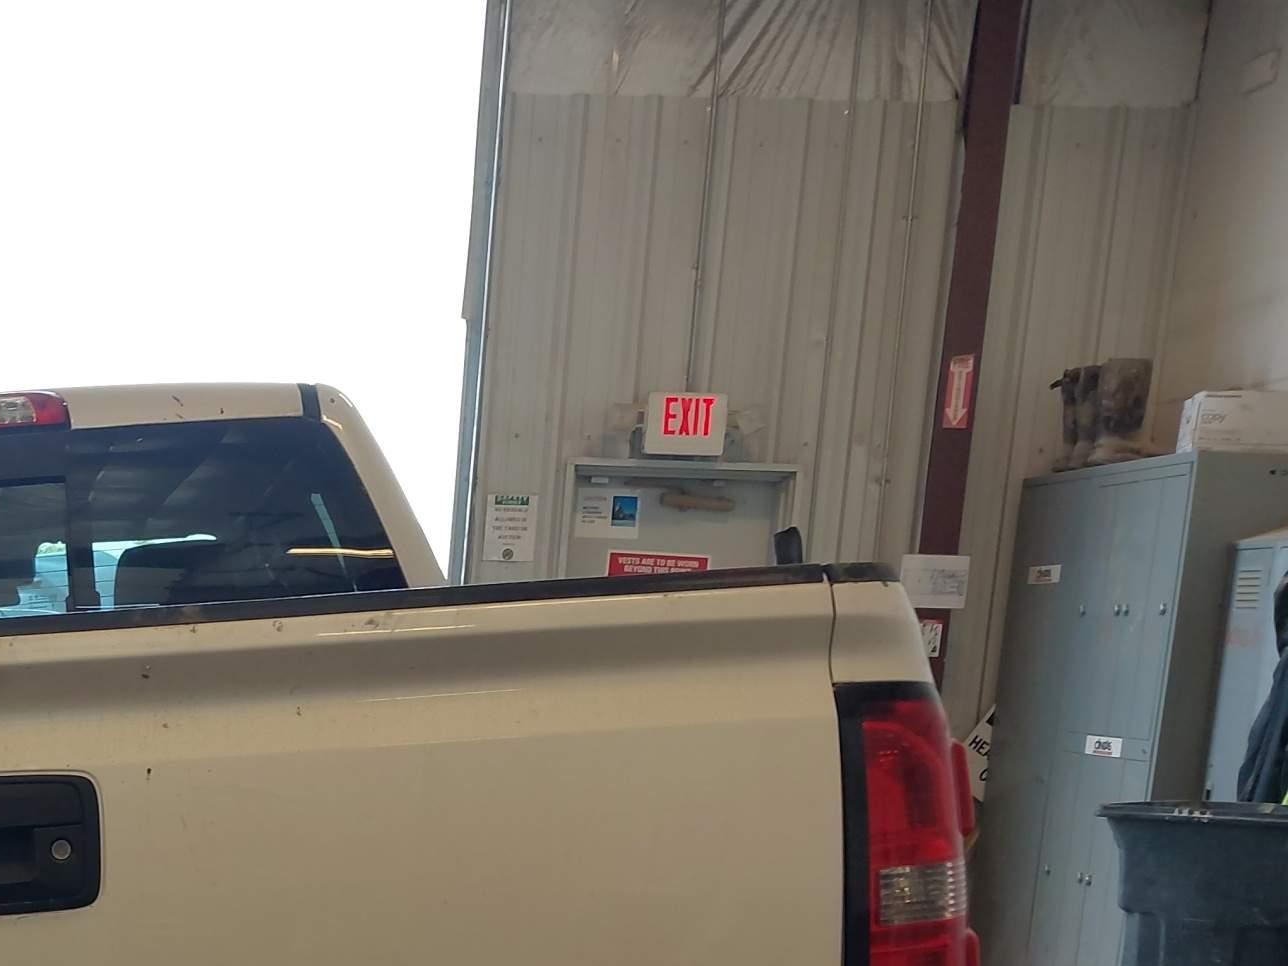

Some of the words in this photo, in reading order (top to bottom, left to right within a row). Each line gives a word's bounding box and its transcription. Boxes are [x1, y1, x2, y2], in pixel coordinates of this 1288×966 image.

[663, 396, 716, 436] EXIT
[618, 557, 640, 565] VESTS
[641, 558, 655, 566] ARE
